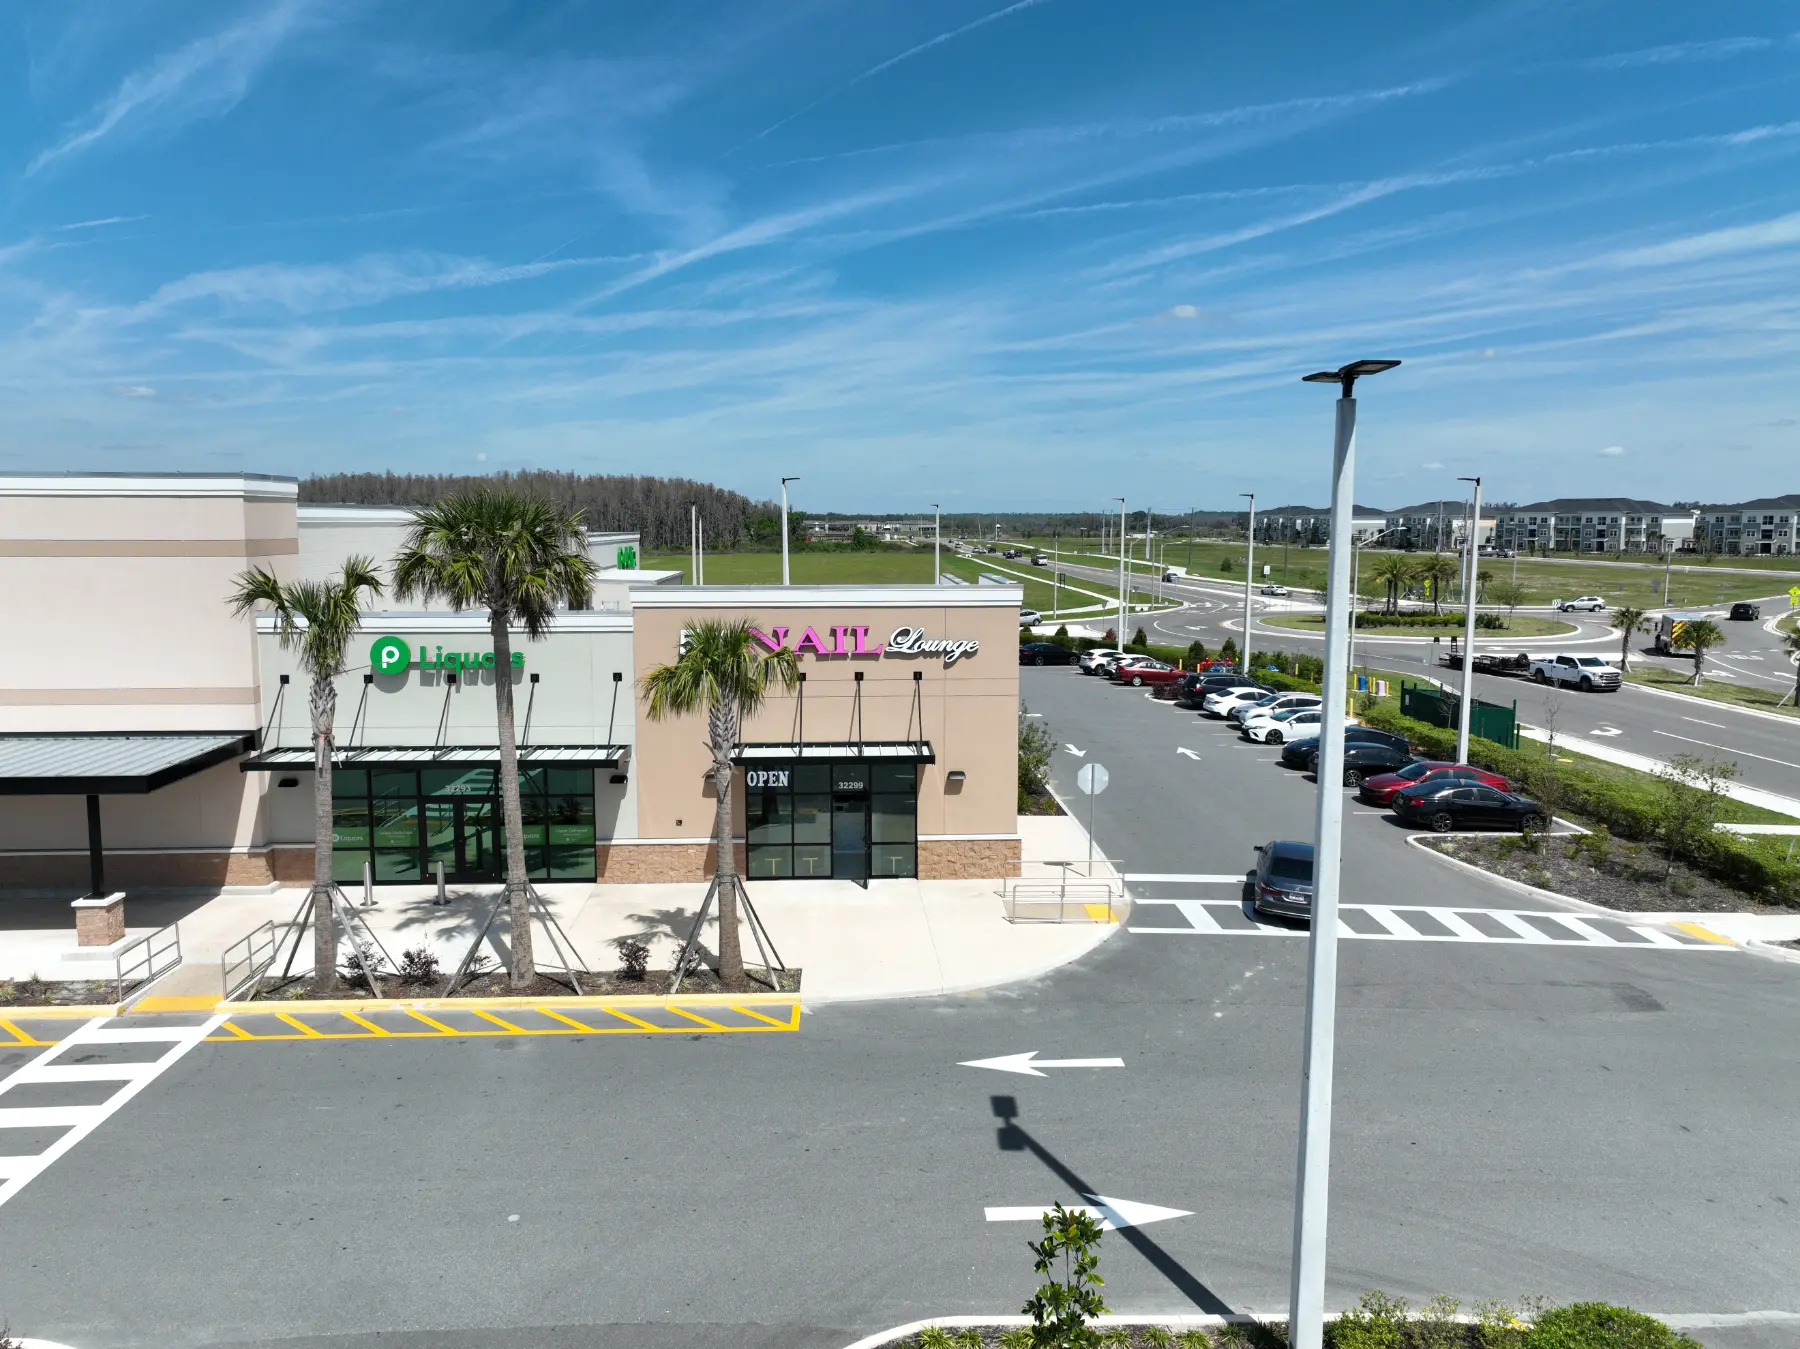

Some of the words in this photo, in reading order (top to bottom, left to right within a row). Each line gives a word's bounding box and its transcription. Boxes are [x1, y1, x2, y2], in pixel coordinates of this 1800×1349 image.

[743, 625, 884, 655] NAIL
[885, 626, 980, 663] Lounge
[419, 645, 526, 676] Liquos
[746, 770, 790, 788] OPEN
[838, 781, 864, 790] 32299
